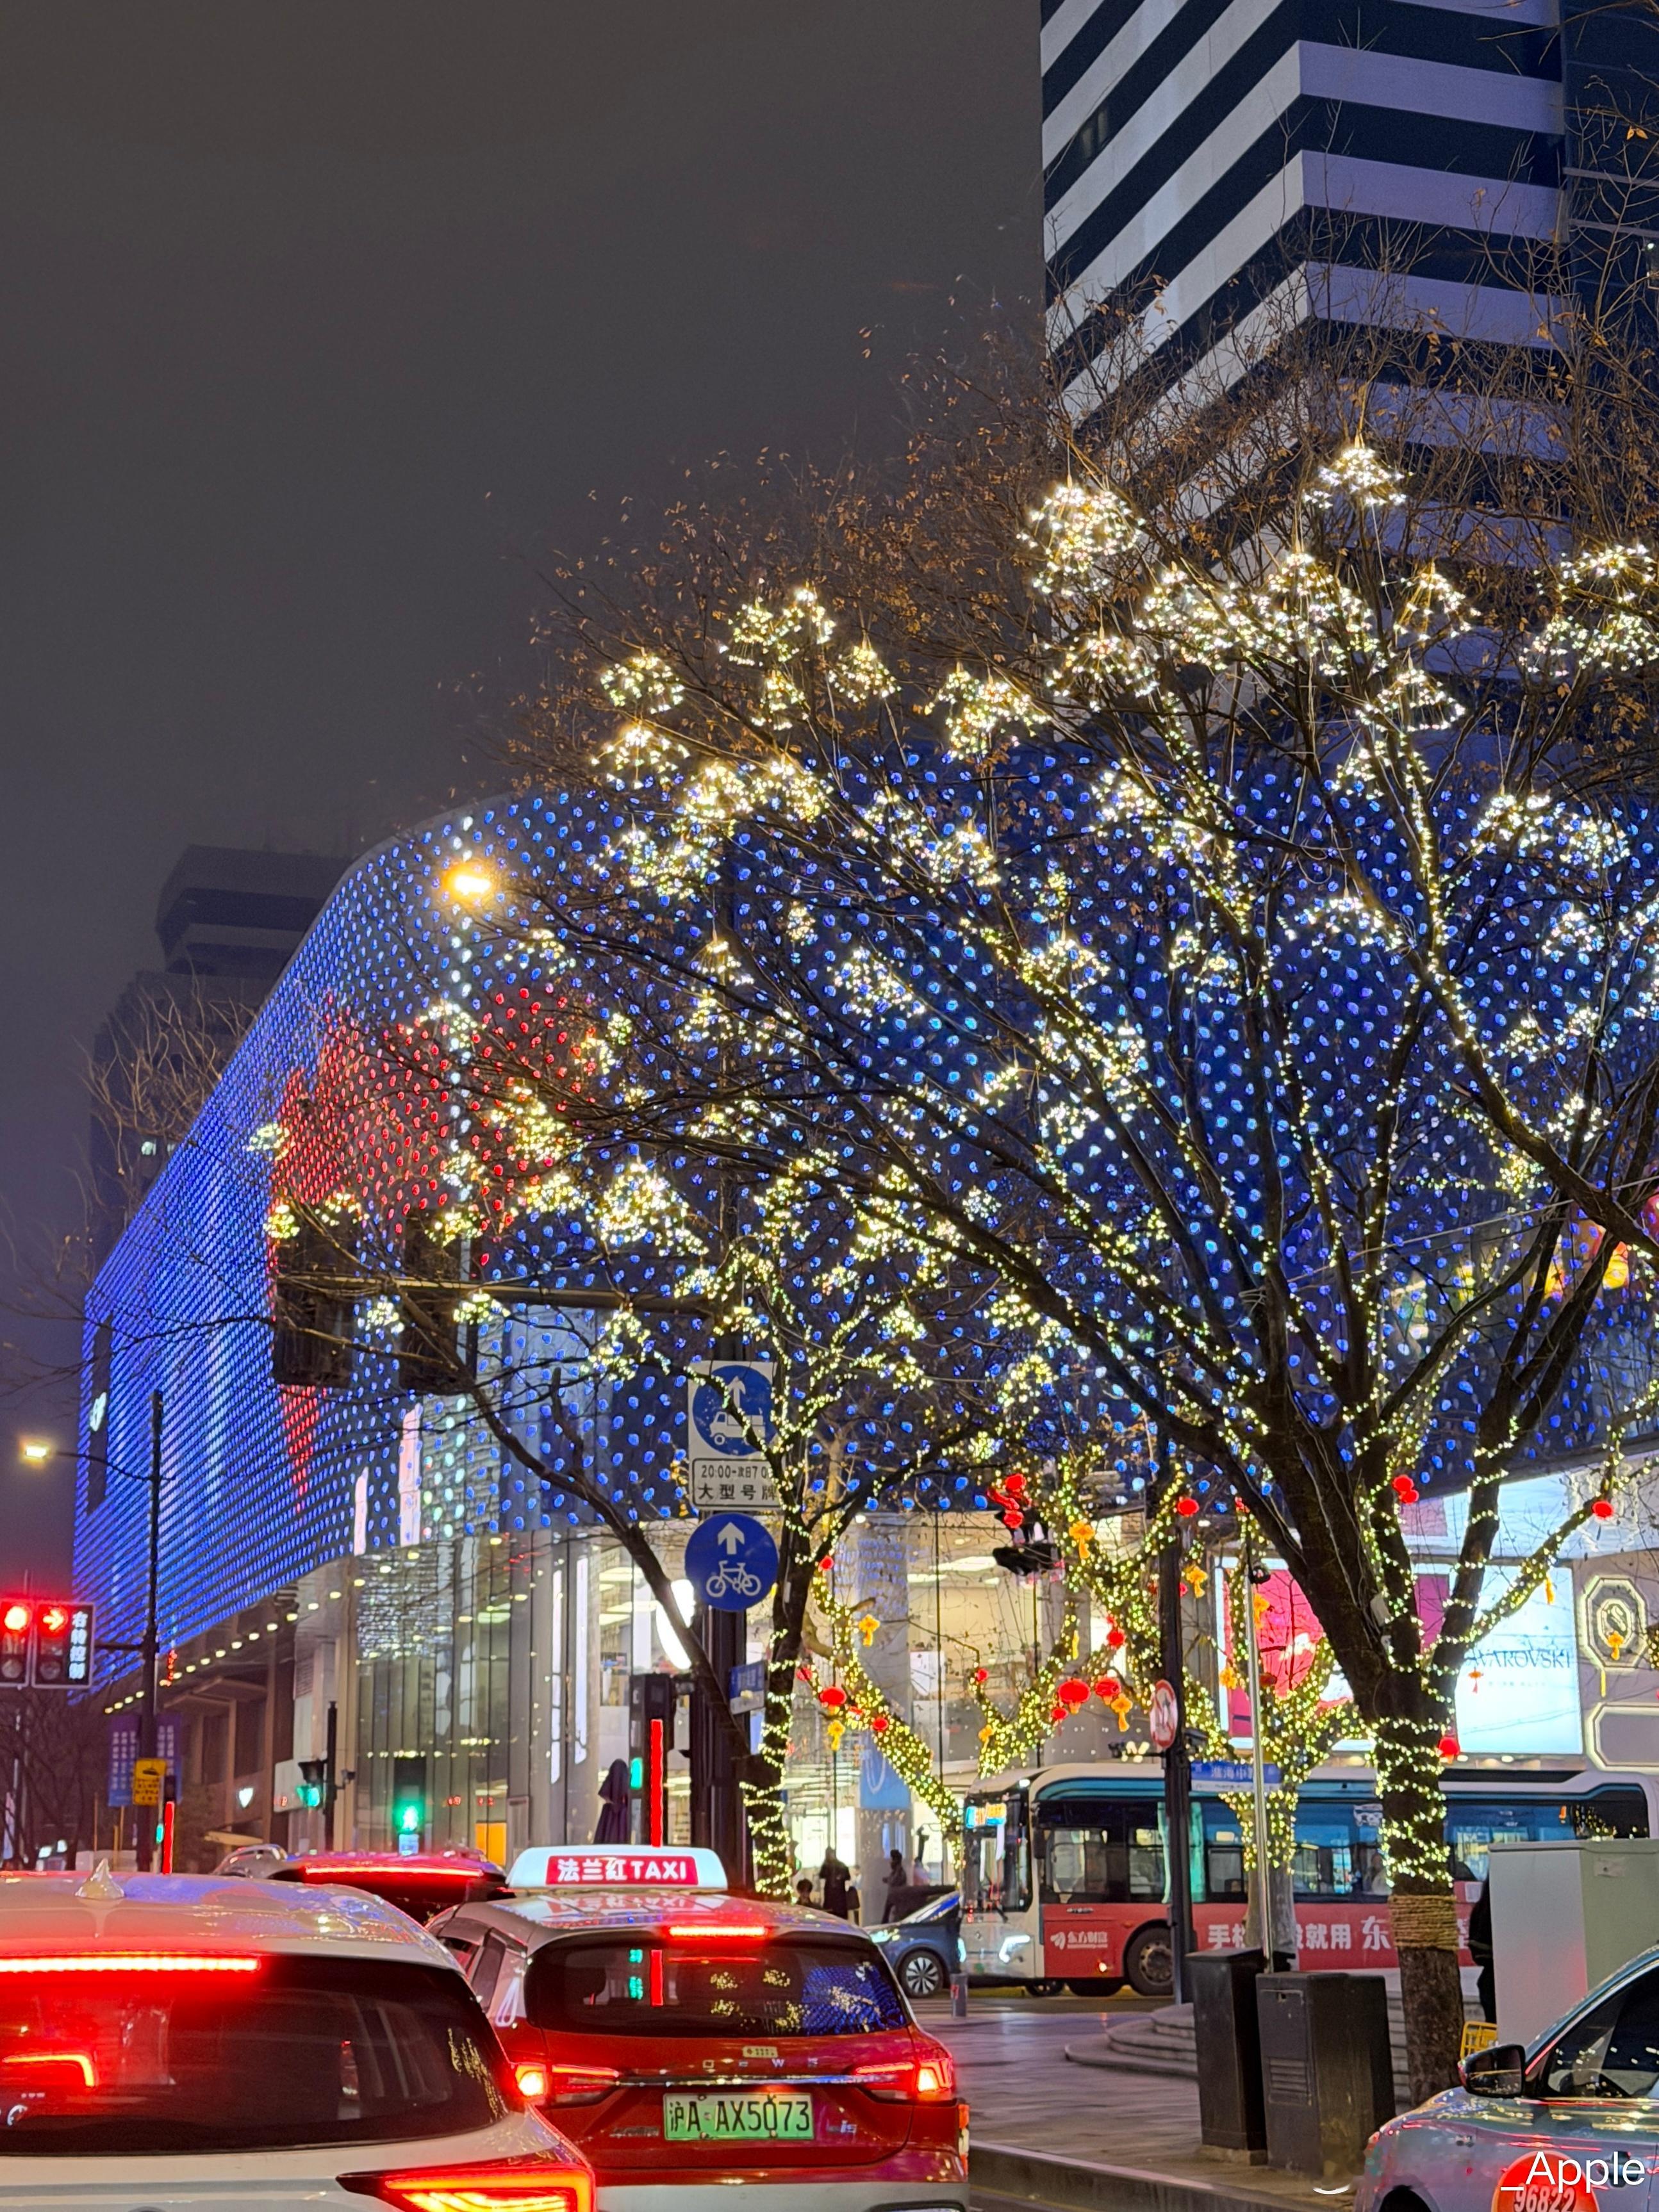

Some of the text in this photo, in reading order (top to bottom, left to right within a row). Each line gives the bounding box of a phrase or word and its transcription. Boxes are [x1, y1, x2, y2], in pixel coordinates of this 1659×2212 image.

[698, 1482, 777, 1500] 大型号牌
[1470, 1649, 1571, 1668] WAROVSKI
[1514, 2183, 1575, 2212] 96822
